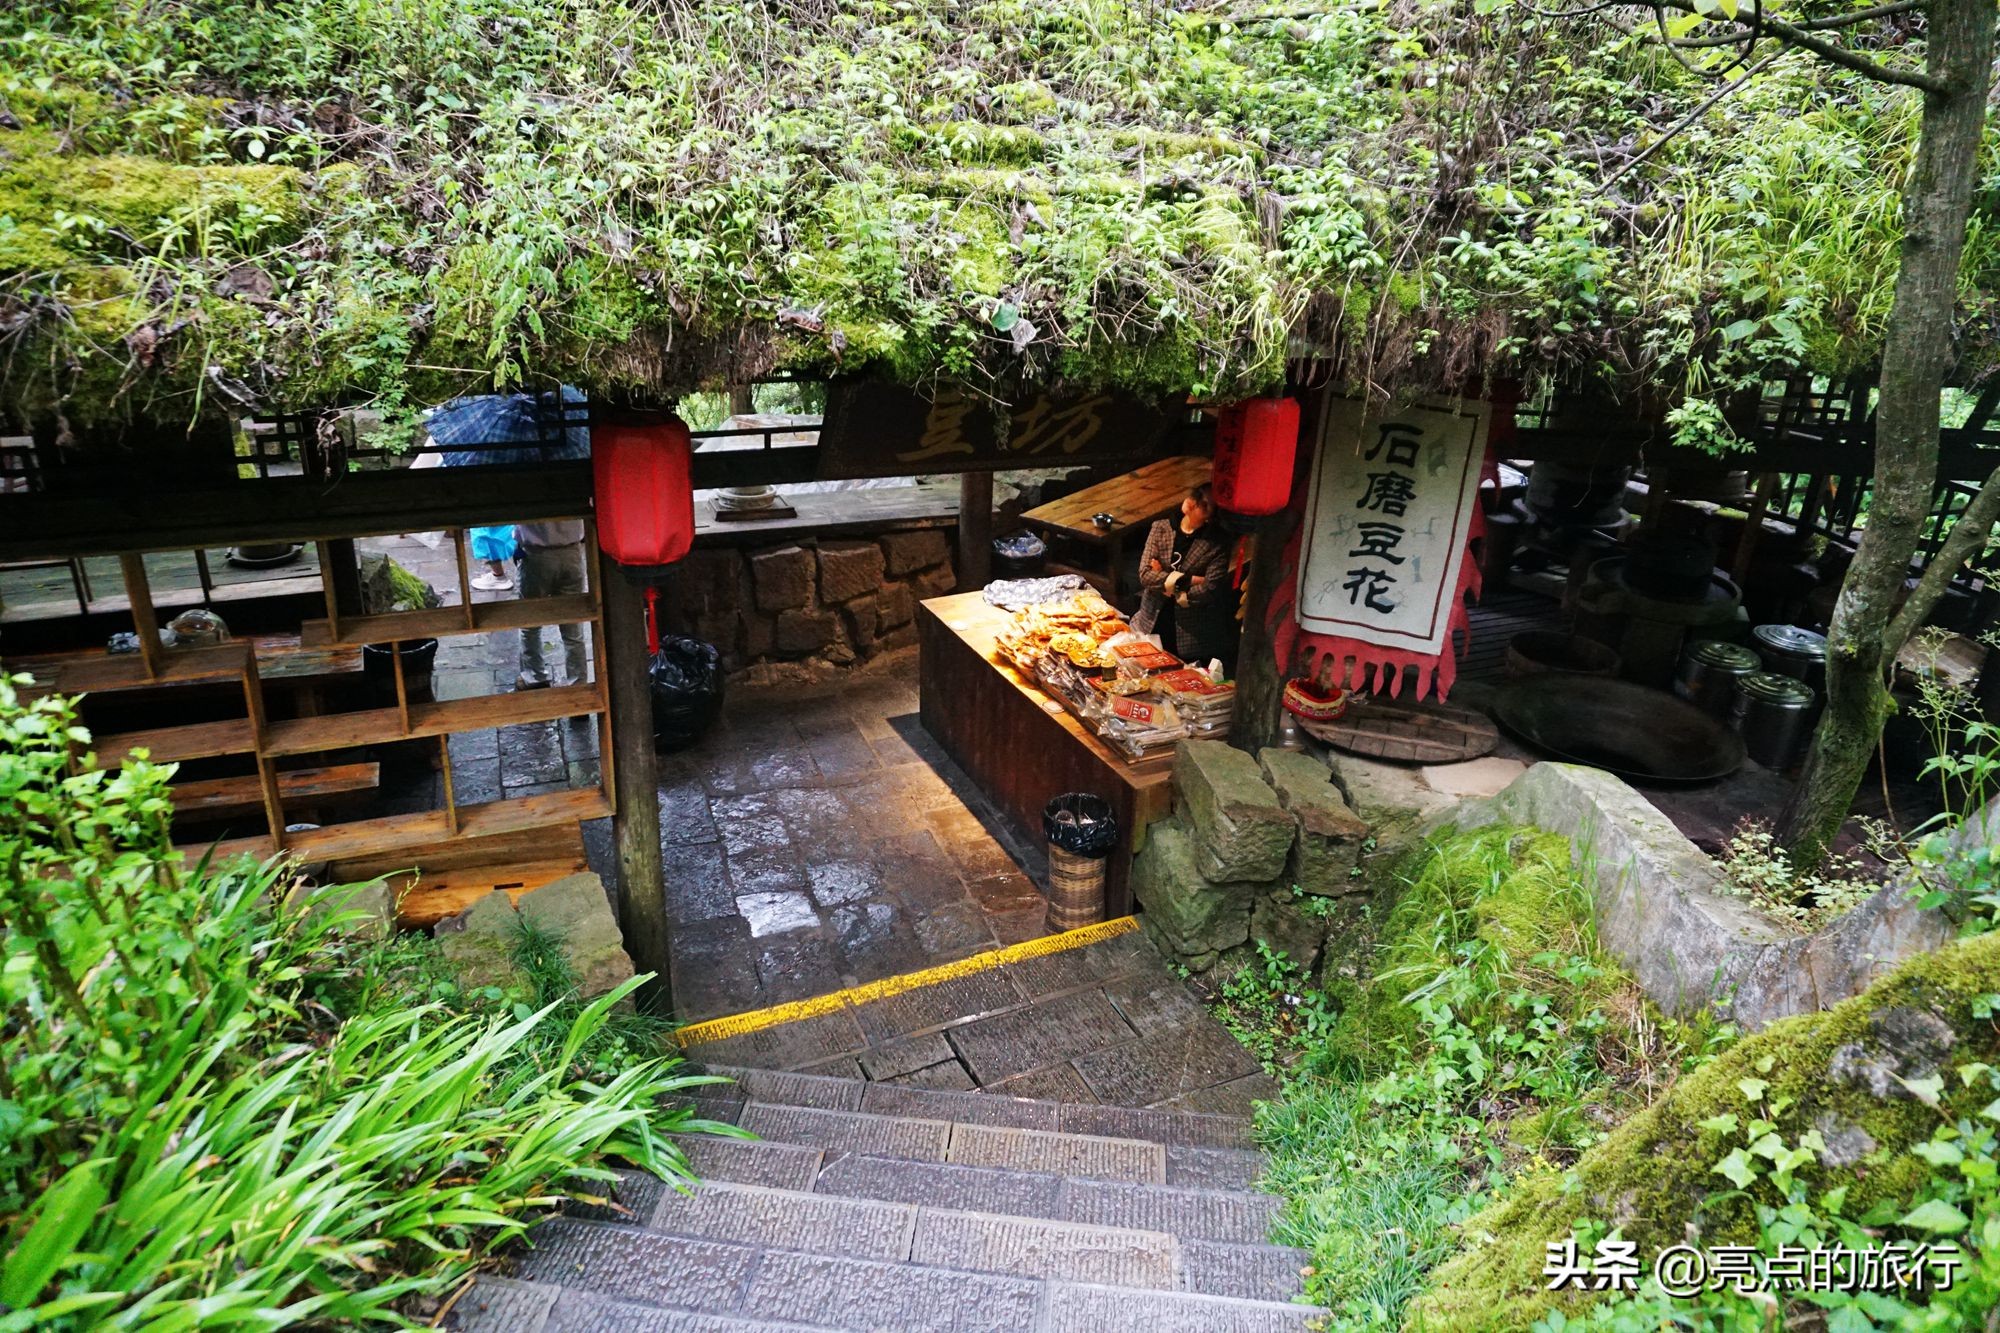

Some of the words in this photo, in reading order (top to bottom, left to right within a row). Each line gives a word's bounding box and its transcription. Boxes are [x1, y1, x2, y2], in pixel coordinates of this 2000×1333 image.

[896, 392, 1113, 463] 豆坊
[1342, 422, 1425, 615] 石磨豆花
